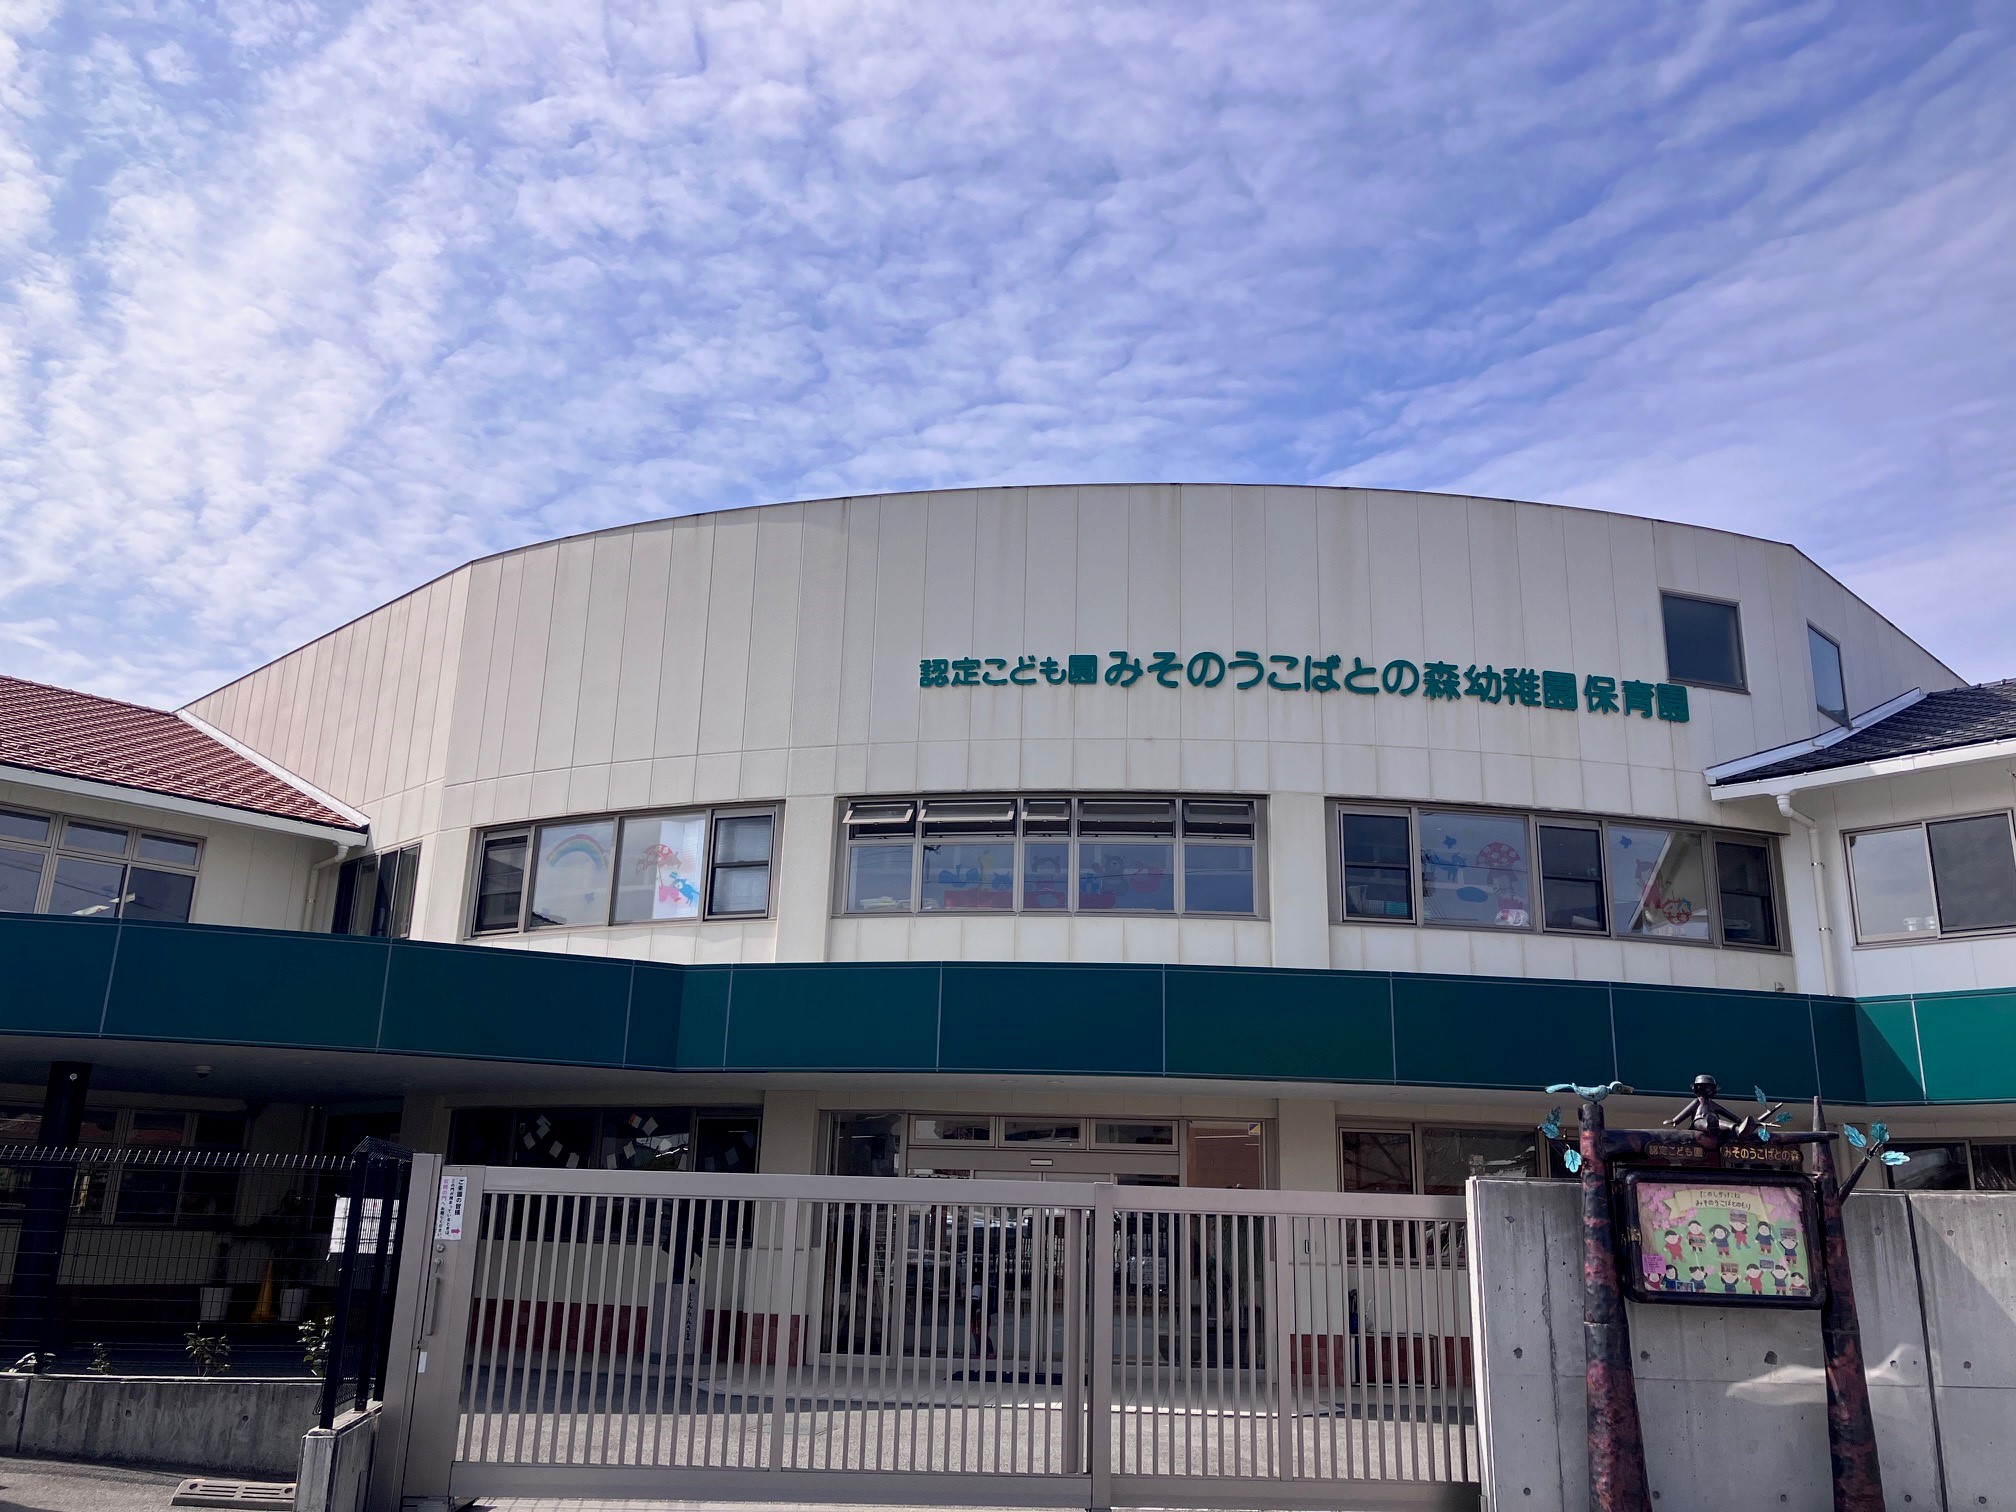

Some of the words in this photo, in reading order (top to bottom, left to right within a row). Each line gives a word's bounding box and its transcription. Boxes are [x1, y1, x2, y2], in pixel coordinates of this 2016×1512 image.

[919, 655, 1098, 688] 認定こども園
[1649, 1145, 1704, 1158] 認定こども園
[1724, 1146, 1800, 1161] みそのうこばとの森
[1695, 1199, 1751, 1211] みそのうこばとのもり
